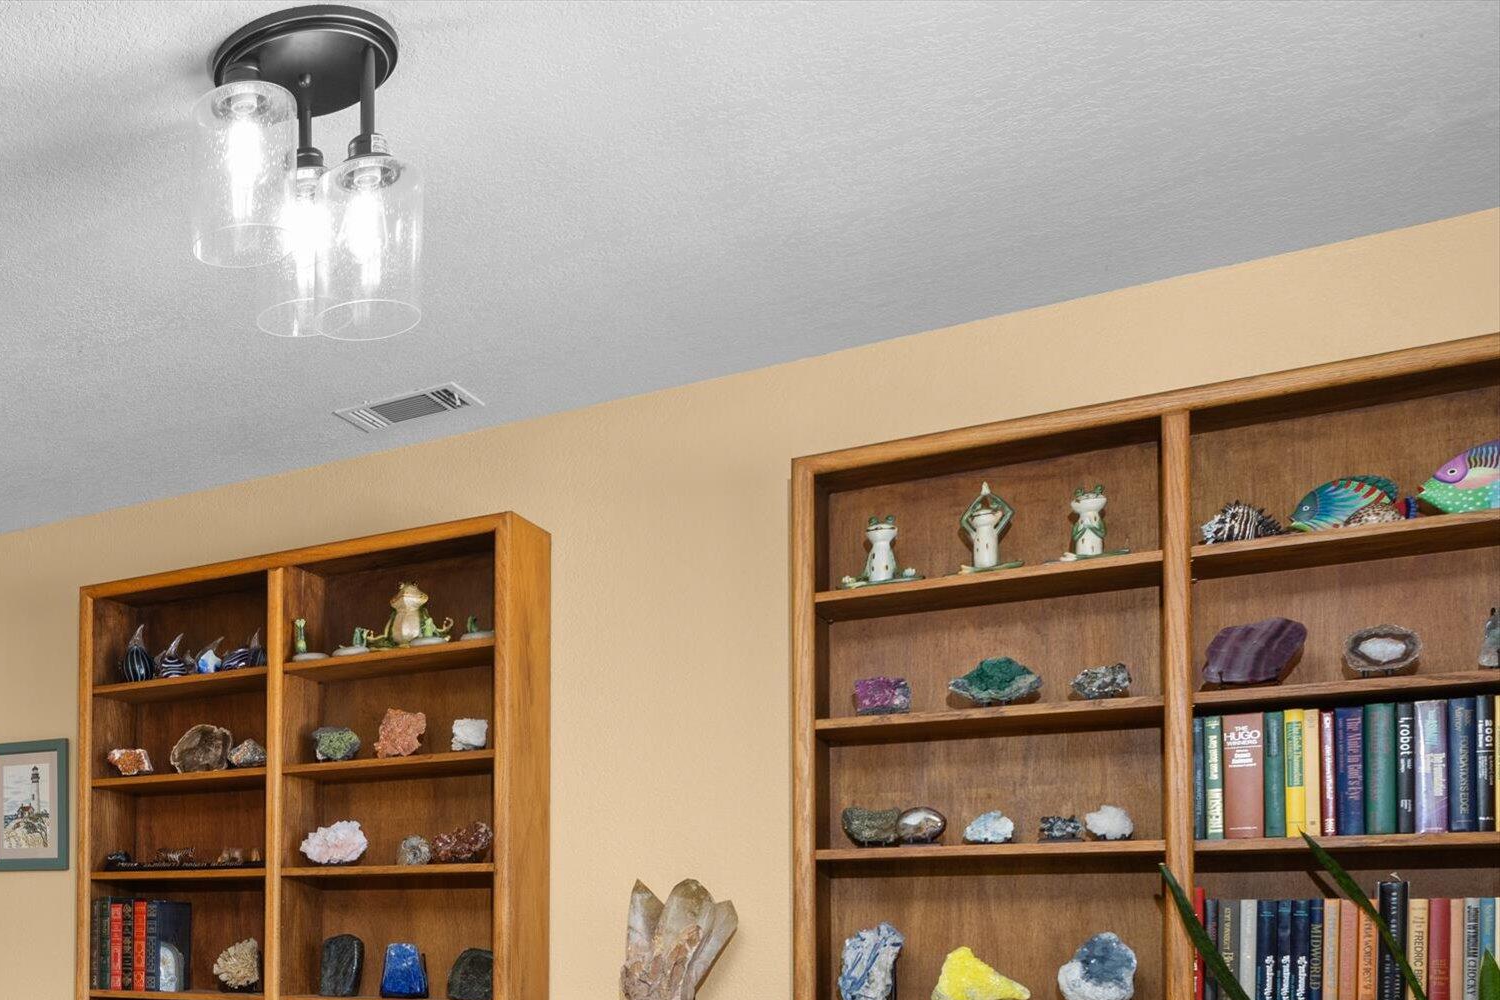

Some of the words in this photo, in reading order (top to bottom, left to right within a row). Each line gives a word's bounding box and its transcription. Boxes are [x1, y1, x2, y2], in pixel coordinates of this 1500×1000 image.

[1223, 730, 1261, 742] HUGO
[1346, 717, 1362, 731] The
[1484, 719, 1493, 747] 2001
[1400, 724, 1413, 755] robot
[1460, 792, 1469, 815] EDGE
[1390, 892, 1398, 915] BRIAN
[1310, 923, 1322, 990] MIDWORLD
[1413, 930, 1424, 966] FREDRIC
[1466, 959, 1477, 997] CHOCKY
